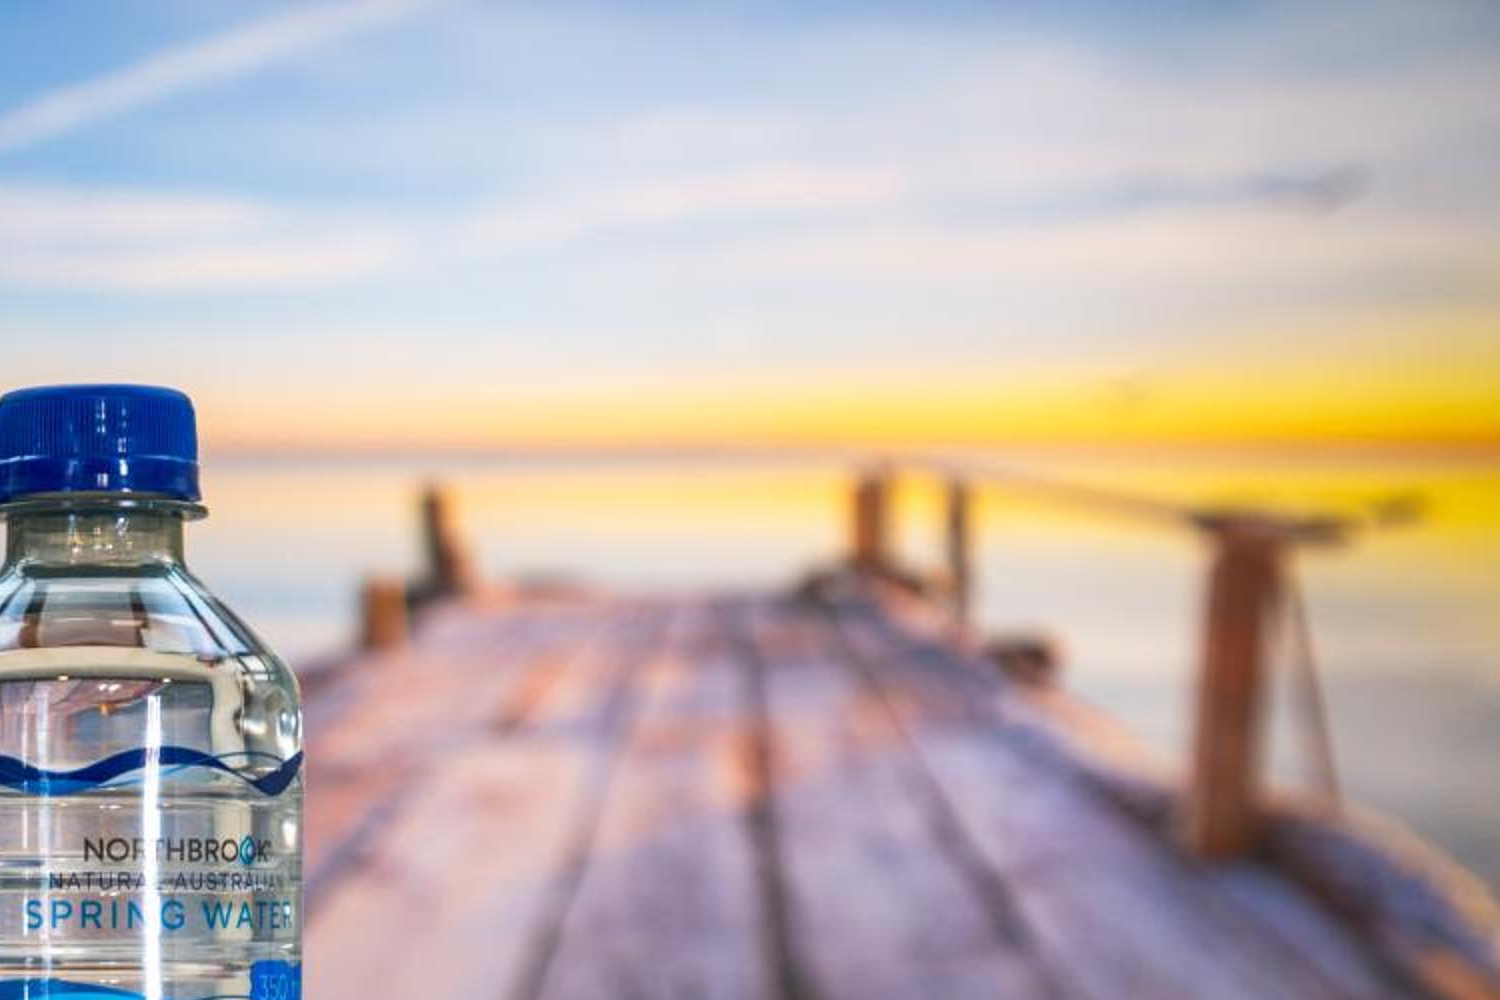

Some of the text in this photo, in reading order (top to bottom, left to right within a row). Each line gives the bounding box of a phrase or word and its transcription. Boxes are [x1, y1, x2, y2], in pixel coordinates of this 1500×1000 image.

[49, 872, 164, 890] NATURA
[26, 899, 292, 930] SPRING WATER
